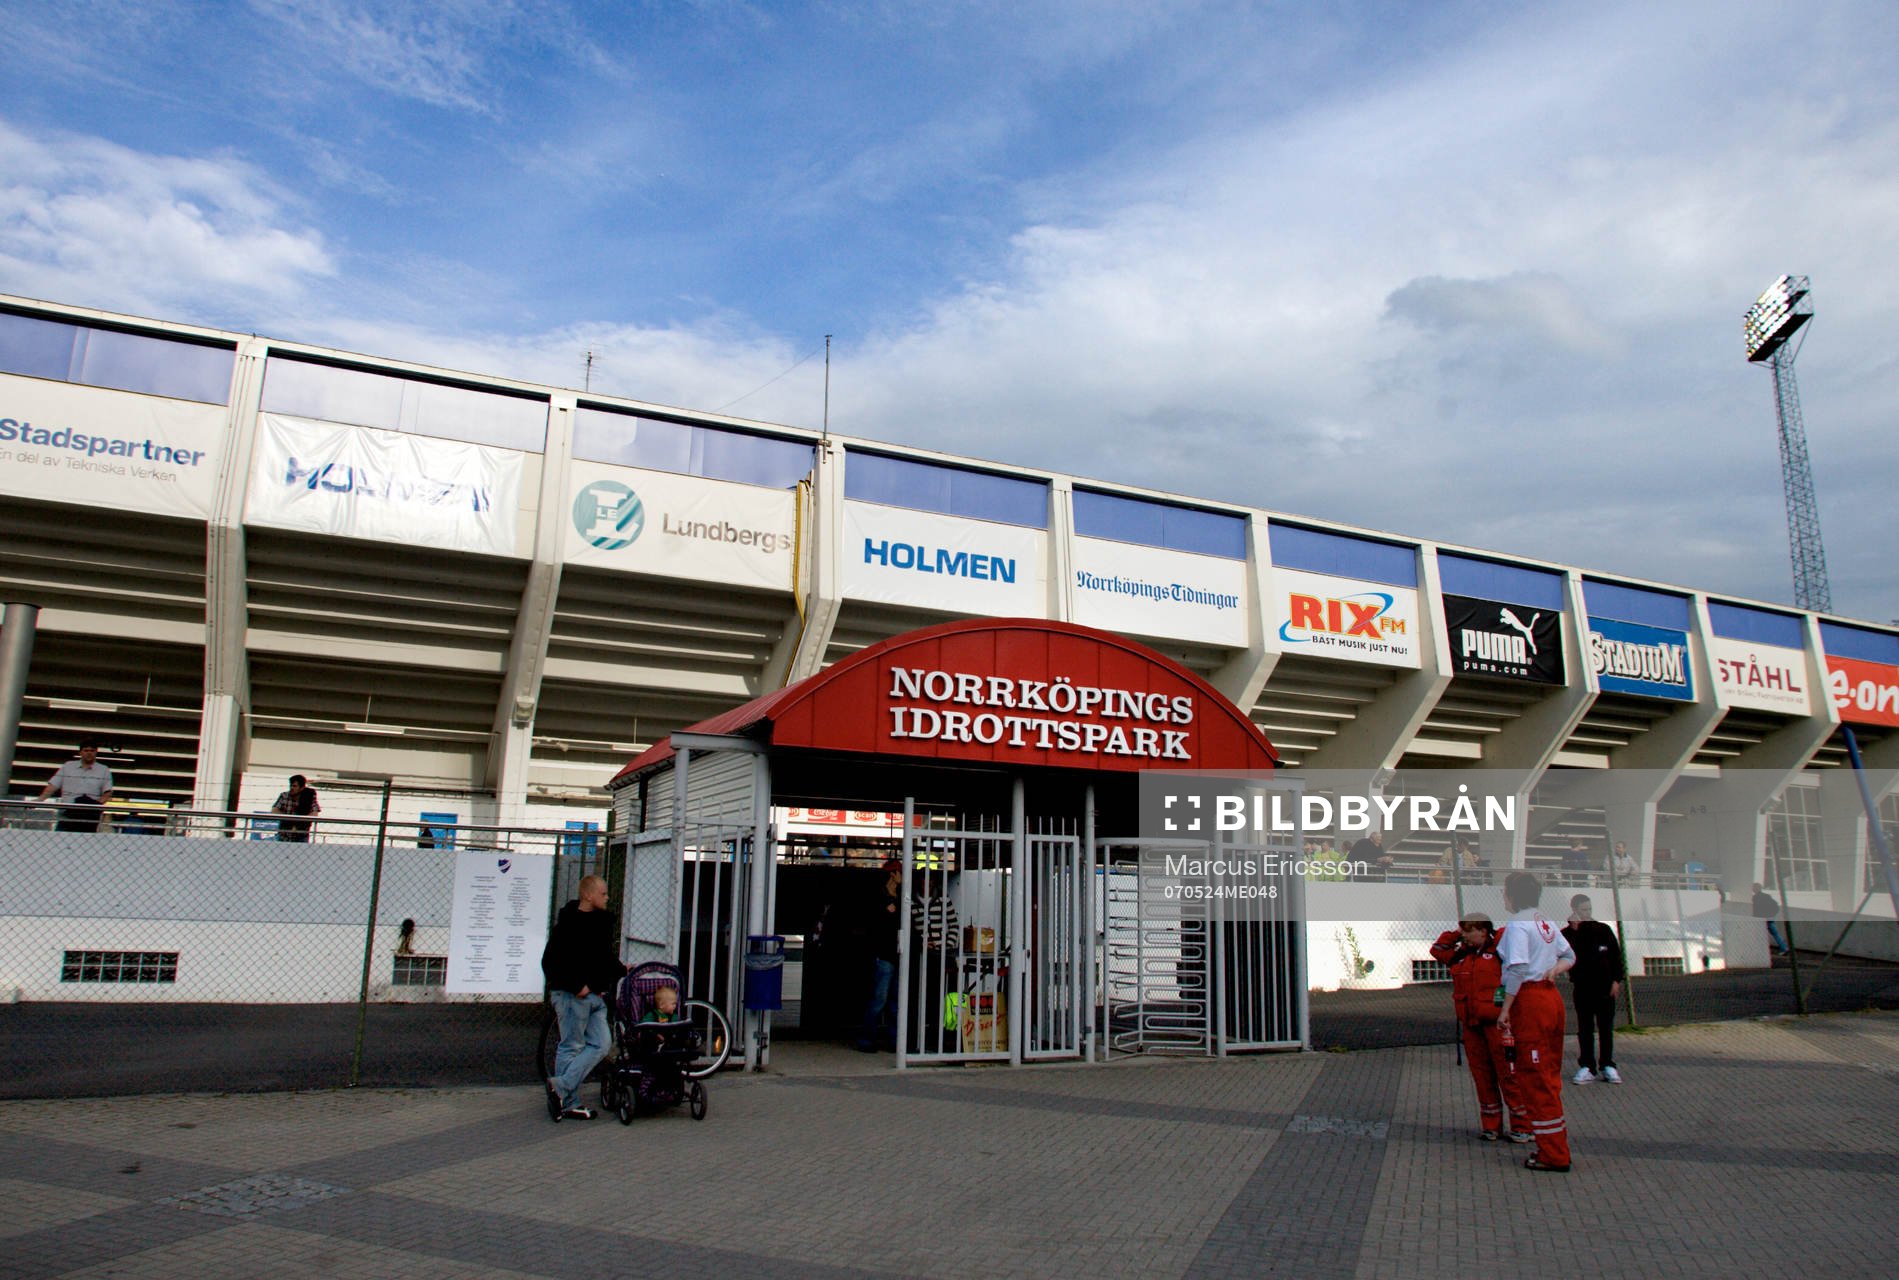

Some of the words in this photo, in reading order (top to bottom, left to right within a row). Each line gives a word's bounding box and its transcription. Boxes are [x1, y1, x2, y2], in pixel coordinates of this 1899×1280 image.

[0, 418, 205, 466] Stadspartner
[17, 451, 39, 464] del
[43, 456, 61, 467] av
[65, 457, 126, 476] Tekniska
[131, 466, 177, 482] Verken
[663, 512, 791, 553] Lundbergs
[864, 538, 1016, 583] HOLMEN
[1076, 569, 1170, 602] Norrköpings
[1170, 583, 1239, 610] Tidningar
[1289, 592, 1384, 640] RIX
[1380, 616, 1406, 635] FM
[1338, 639, 1367, 650] MUSIK
[1369, 643, 1389, 652] JUST
[1391, 646, 1408, 655] NU!
[1461, 629, 1527, 665] PUMA
[1590, 631, 1687, 686] STADIUM
[1463, 661, 1528, 676] puma.com
[1718, 654, 1802, 693] STÅHL
[890, 667, 1194, 724] NORRKÖPINGS
[890, 707, 1191, 759] IDROTTSPARK
